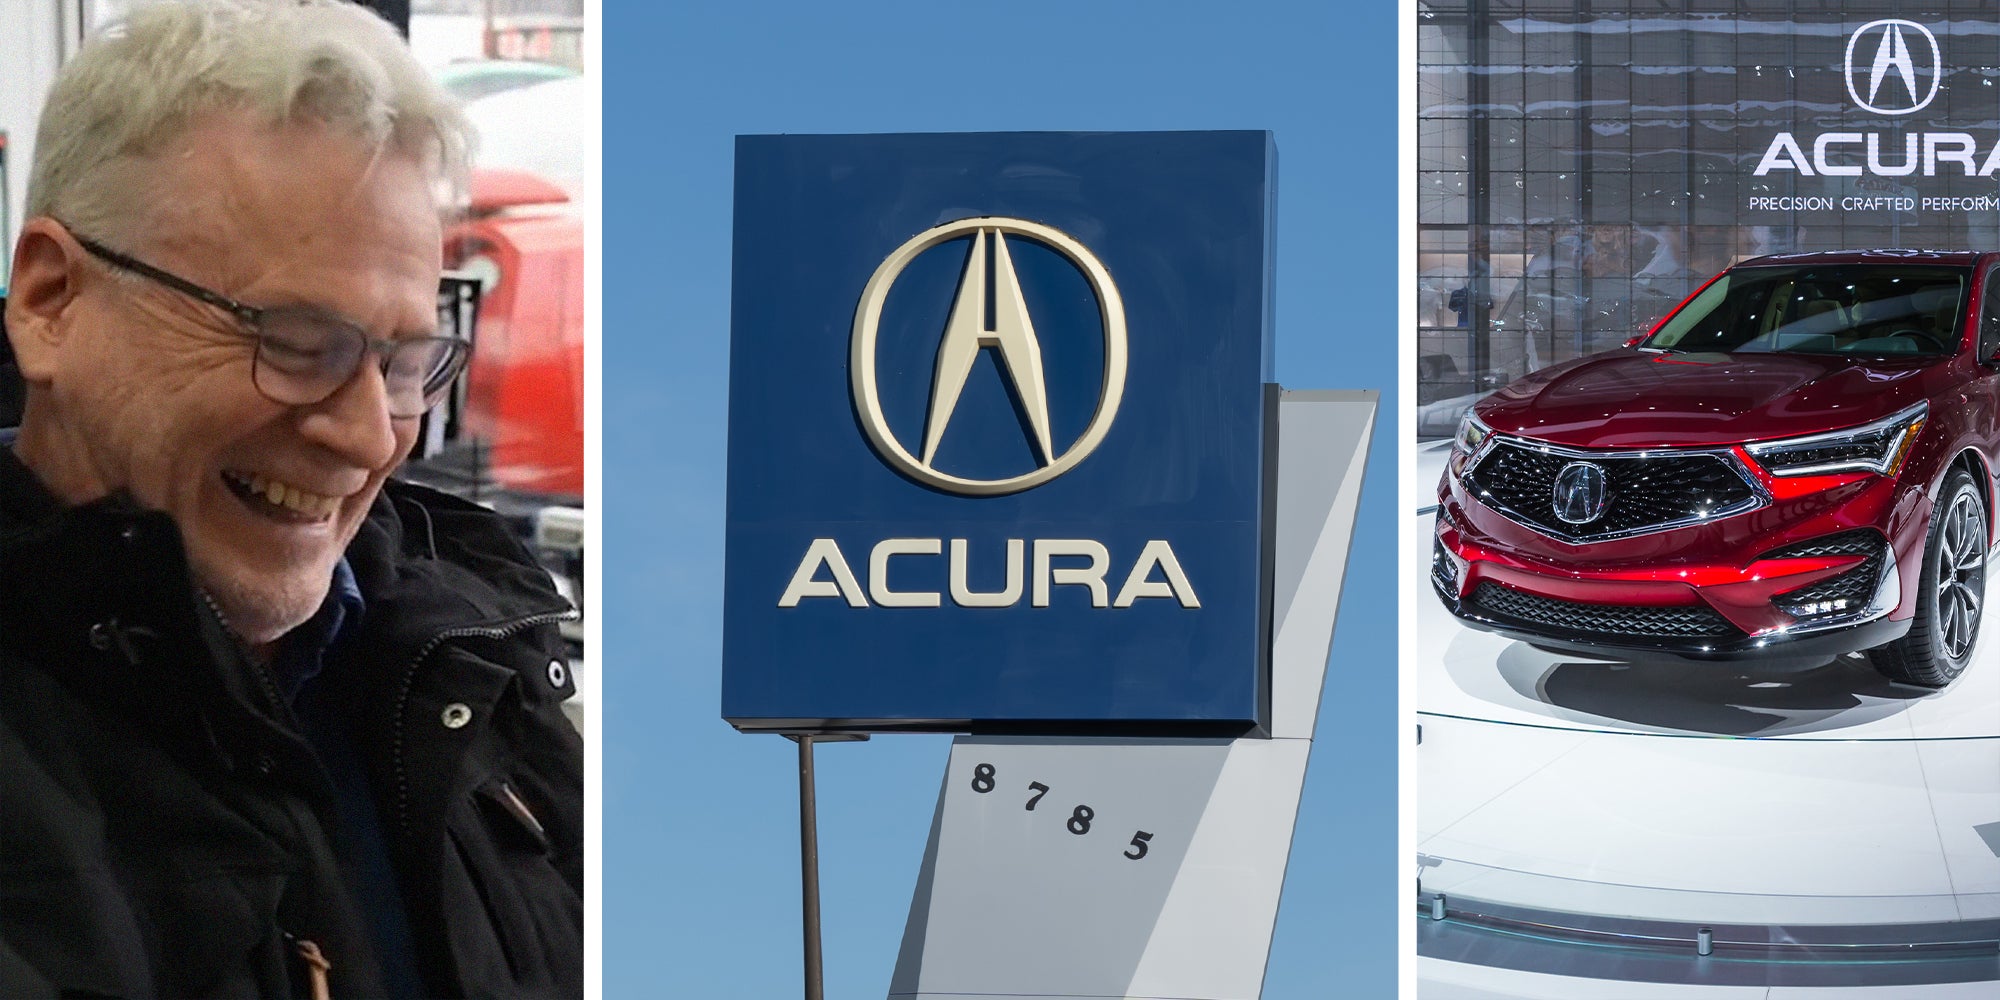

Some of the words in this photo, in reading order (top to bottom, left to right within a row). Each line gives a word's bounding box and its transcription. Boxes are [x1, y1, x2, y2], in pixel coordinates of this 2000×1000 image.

[1749, 197, 1833, 211] PRECISION
[1841, 197, 1915, 211] CRAFTED
[1922, 197, 2000, 211] PERFORM
[778, 538, 1201, 608] ACURA
